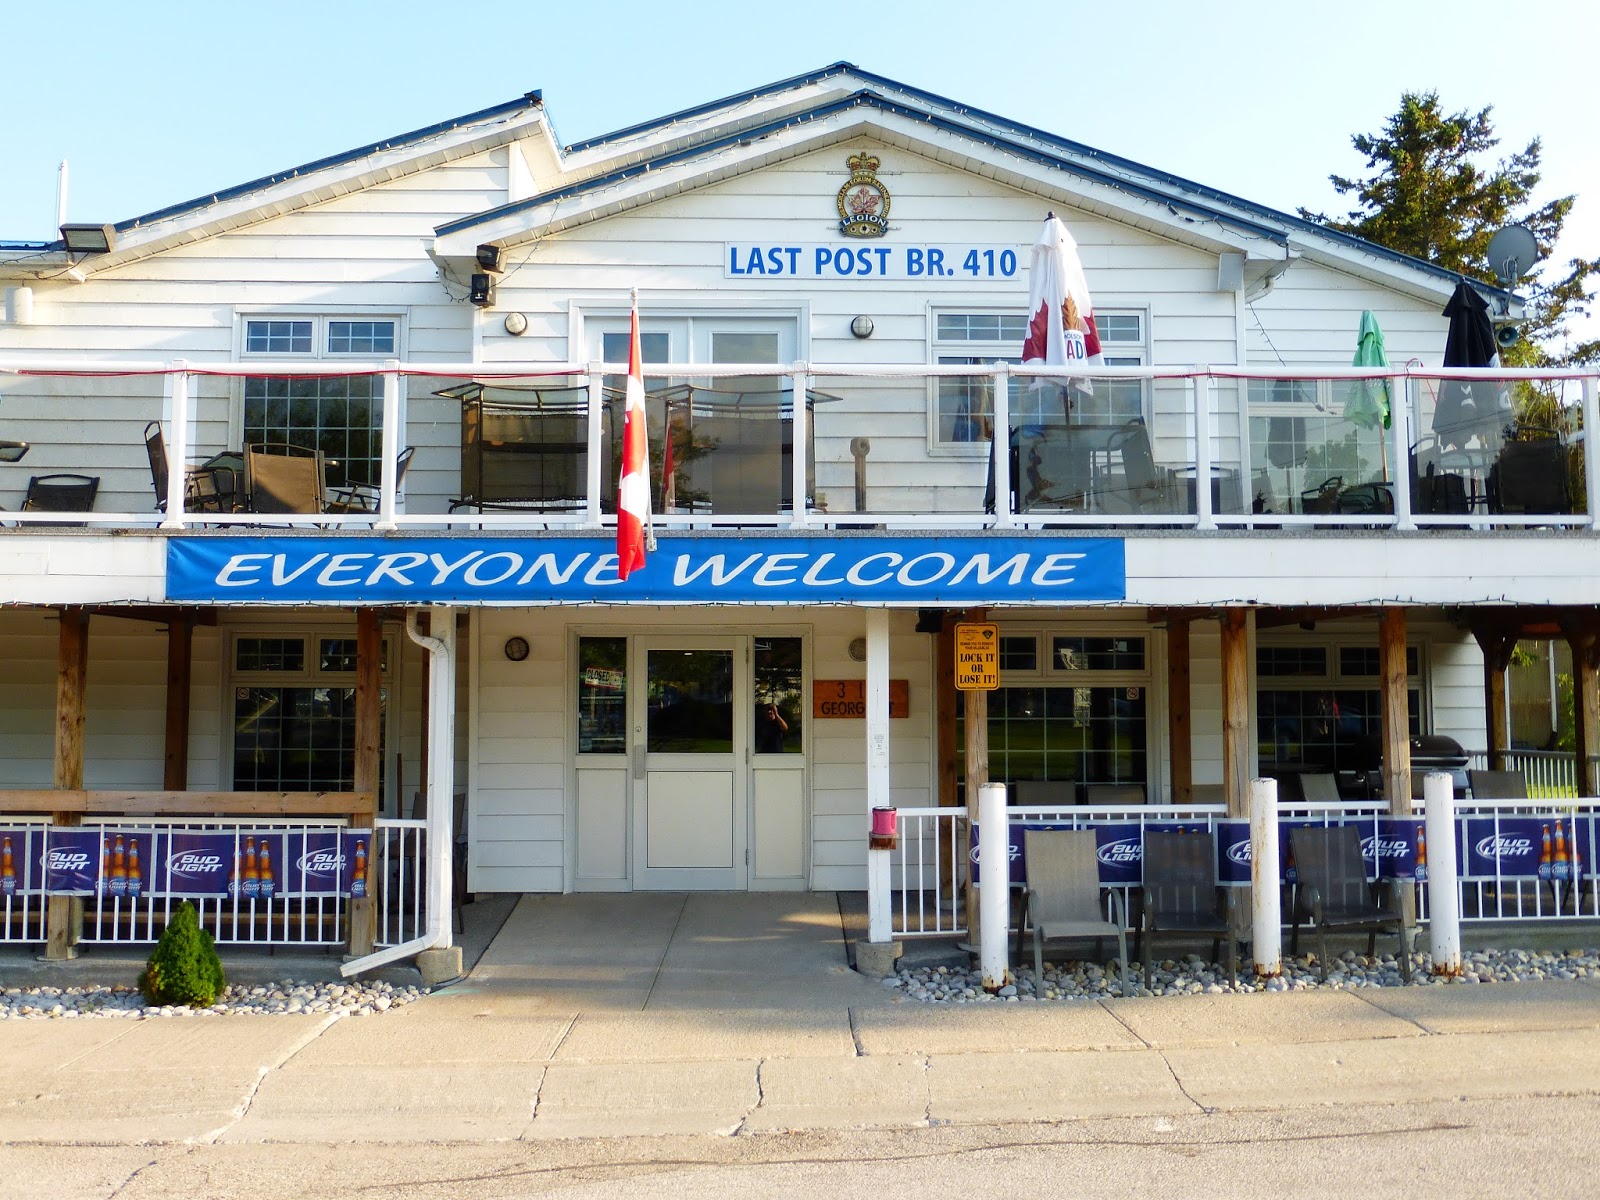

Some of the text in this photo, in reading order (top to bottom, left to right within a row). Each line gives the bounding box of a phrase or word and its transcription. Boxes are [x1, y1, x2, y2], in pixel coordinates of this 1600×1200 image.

[843, 214, 887, 226] LEGION
[730, 247, 1017, 276] LAST POST BR. 410
[214, 550, 1087, 586] EVERYONE WELCOME
[960, 653, 995, 662] LOCK IT
[971, 664, 984, 673] OR
[586, 669, 610, 682] CLOSED
[959, 674, 996, 684] LOSE IT!
[821, 701, 866, 715] GEORG
[1103, 853, 1142, 861] LIGH
[1362, 848, 1410, 857] LIGHT
[180, 854, 221, 864] BUD
[172, 863, 223, 872] LIGHT
